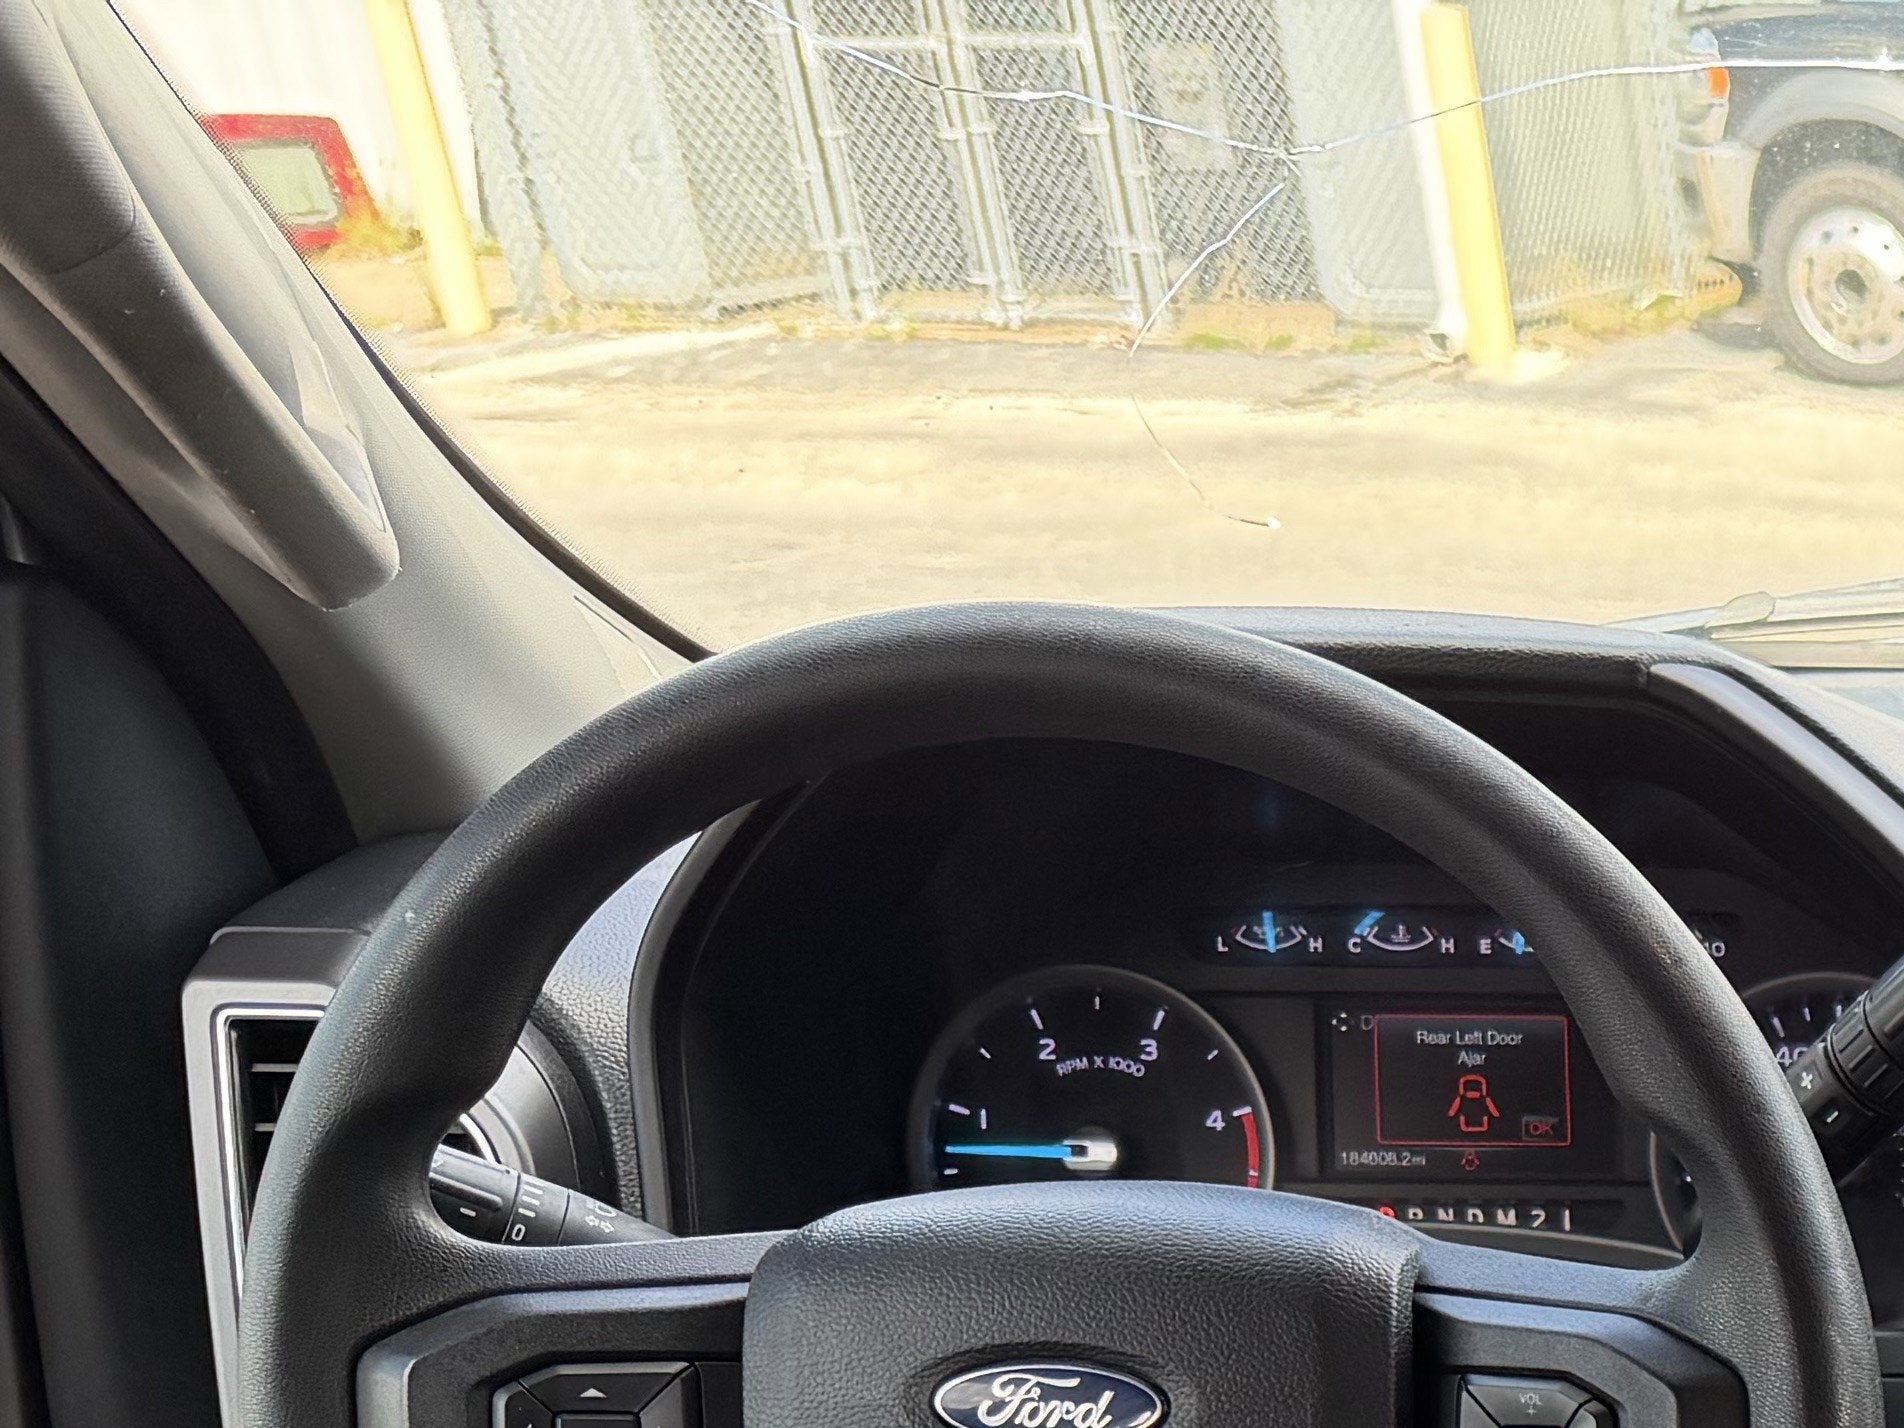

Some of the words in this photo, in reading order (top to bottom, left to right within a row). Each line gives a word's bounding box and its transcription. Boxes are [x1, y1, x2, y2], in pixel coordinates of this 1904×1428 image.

[1216, 937, 1228, 952] L
[1308, 938, 1323, 954] H
[1348, 938, 1362, 954] C
[1440, 938, 1455, 954] H
[1480, 939, 1492, 954] E
[1417, 1029, 1452, 1046] Rear
[1456, 1029, 1484, 1046] Left
[1487, 1029, 1523, 1046] Door
[1039, 1039, 1057, 1061] 2
[1140, 1039, 1158, 1061] 3
[1458, 1049, 1486, 1068] Ajar
[1055, 1056, 1088, 1077] RPM
[1108, 1056, 1146, 1078] 1000
[979, 1109, 988, 1129] 1
[1206, 1109, 1225, 1130] 4
[1528, 1119, 1554, 1136] OK
[1497, 1208, 1516, 1226] M
[1531, 1210, 1546, 1228] 2
[1519, 1393, 1541, 1406] VOL
